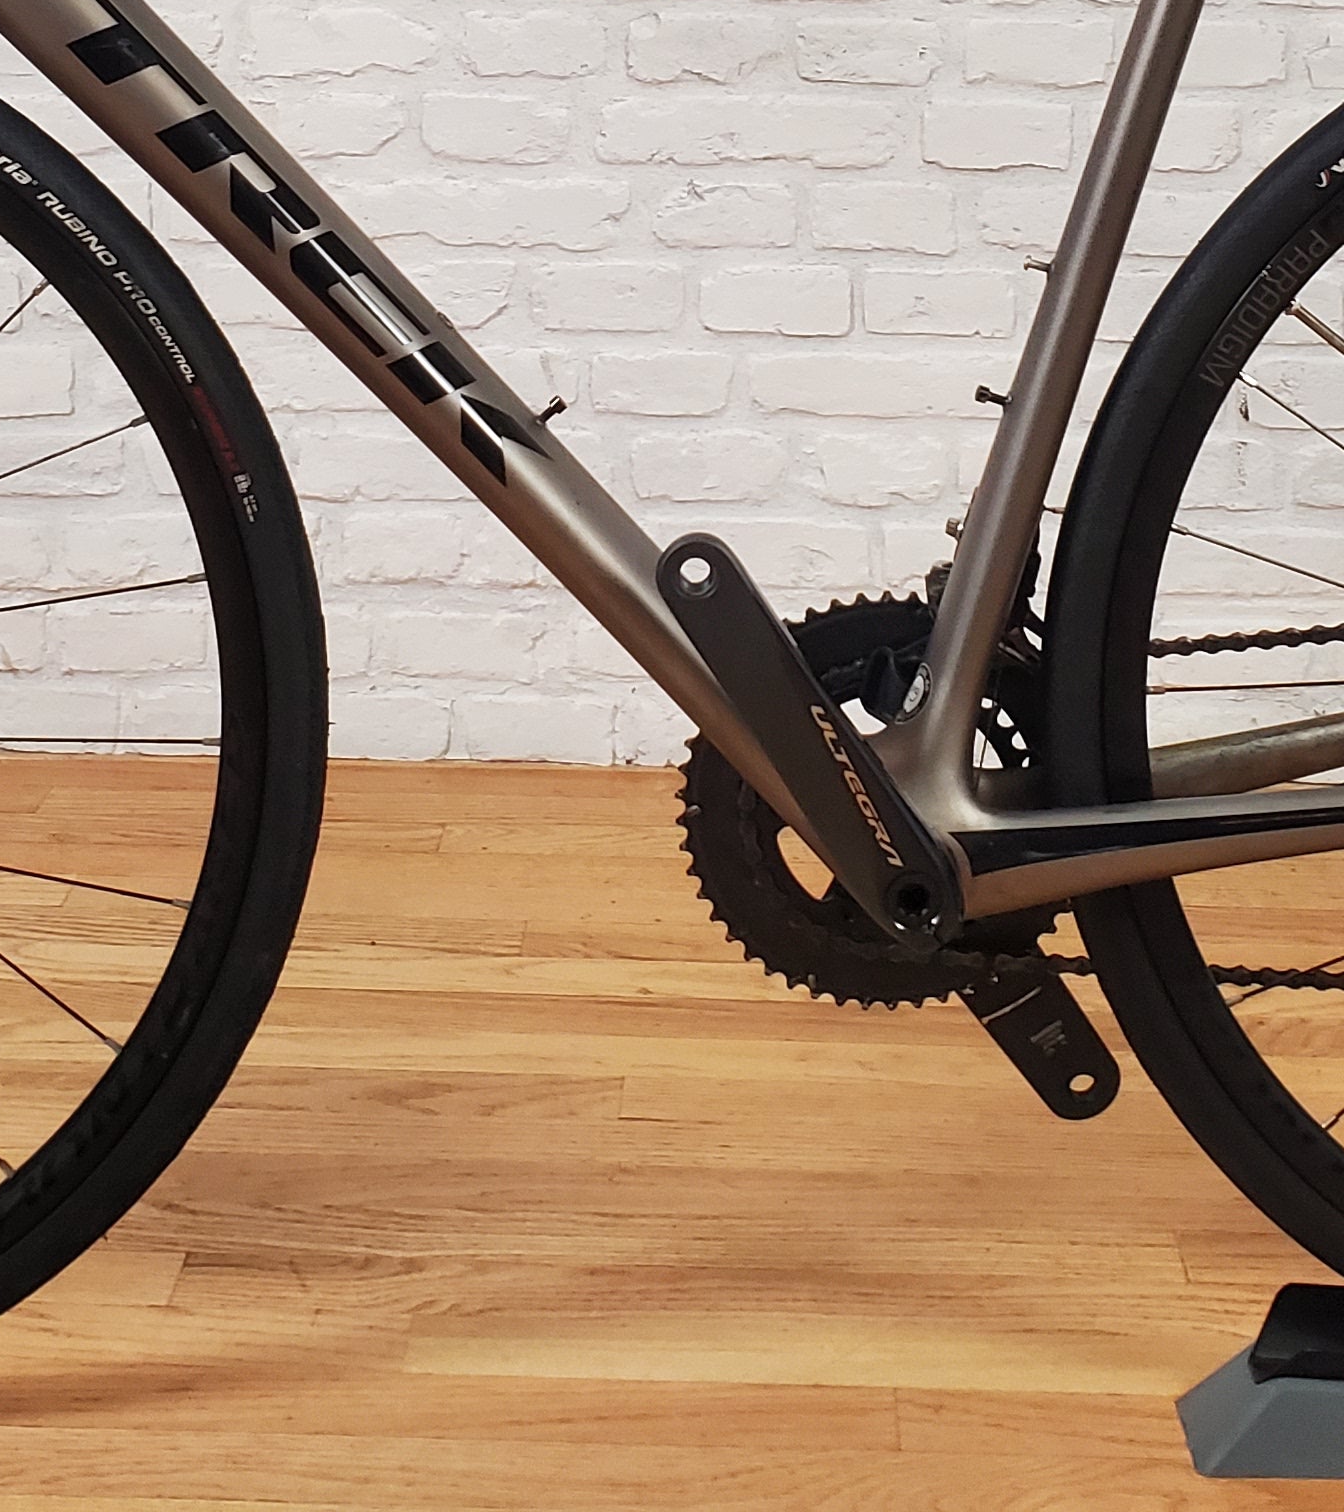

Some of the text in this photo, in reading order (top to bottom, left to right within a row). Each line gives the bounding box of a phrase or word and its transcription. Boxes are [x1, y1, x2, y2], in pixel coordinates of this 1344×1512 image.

[36, 189, 117, 268] RUBINO
[113, 269, 157, 317] PRO
[148, 315, 196, 385] CONTROL
[810, 704, 904, 868] ULTEGRA
